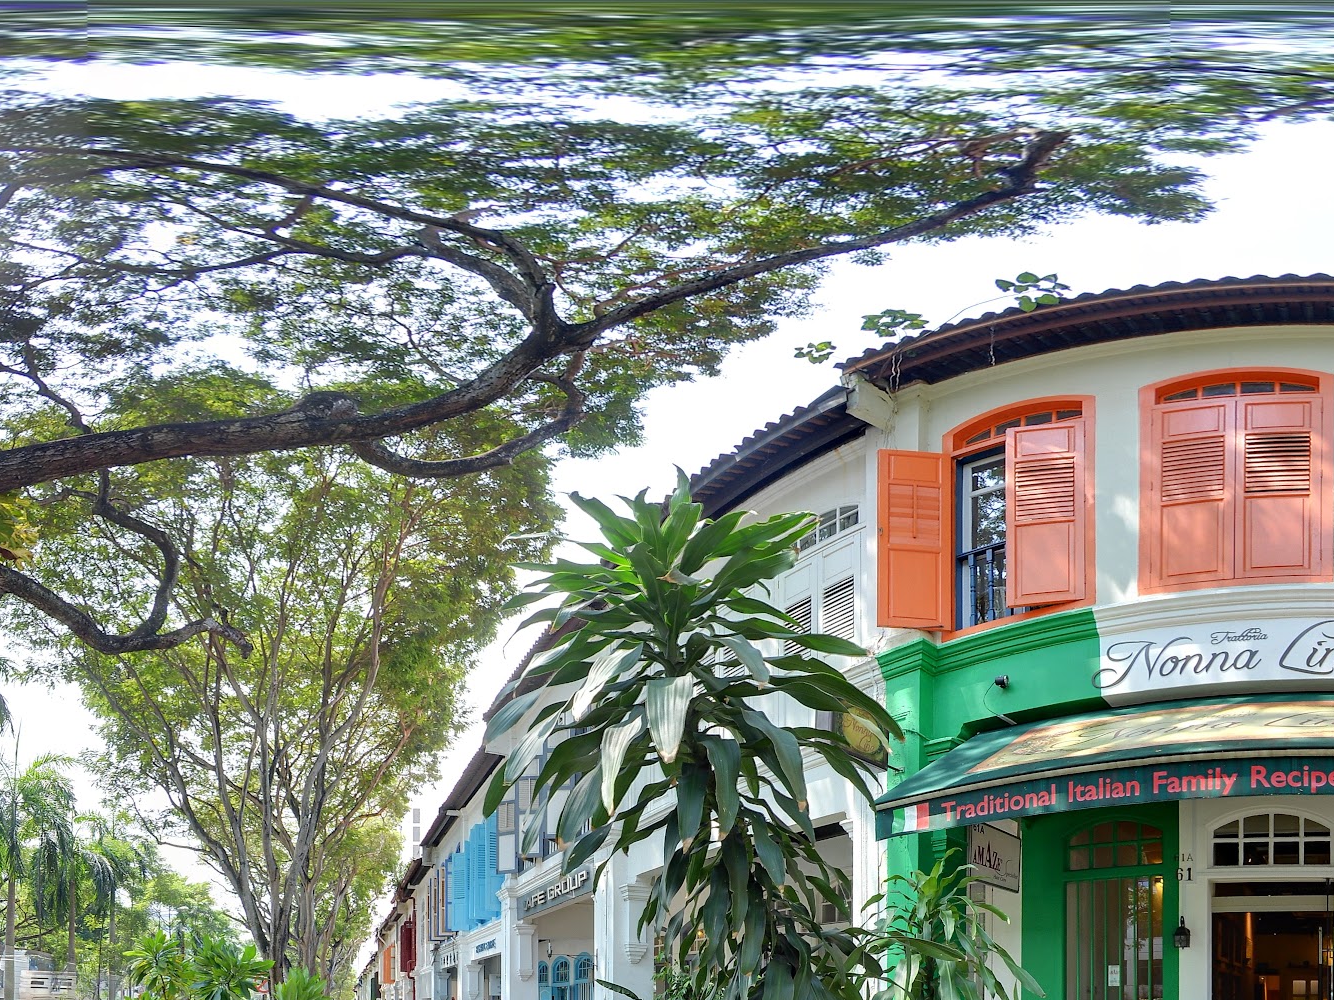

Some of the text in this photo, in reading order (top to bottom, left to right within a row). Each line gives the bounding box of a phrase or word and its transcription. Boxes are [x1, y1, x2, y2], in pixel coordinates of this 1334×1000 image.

[1210, 627, 1268, 645] Trattoria
[1091, 636, 1262, 689] Nonna
[941, 784, 1056, 822] Traditional
[1068, 778, 1140, 802] Italian
[1152, 767, 1238, 795] Family
[547, 870, 588, 901] GROUP
[1177, 867, 1193, 881] 61
